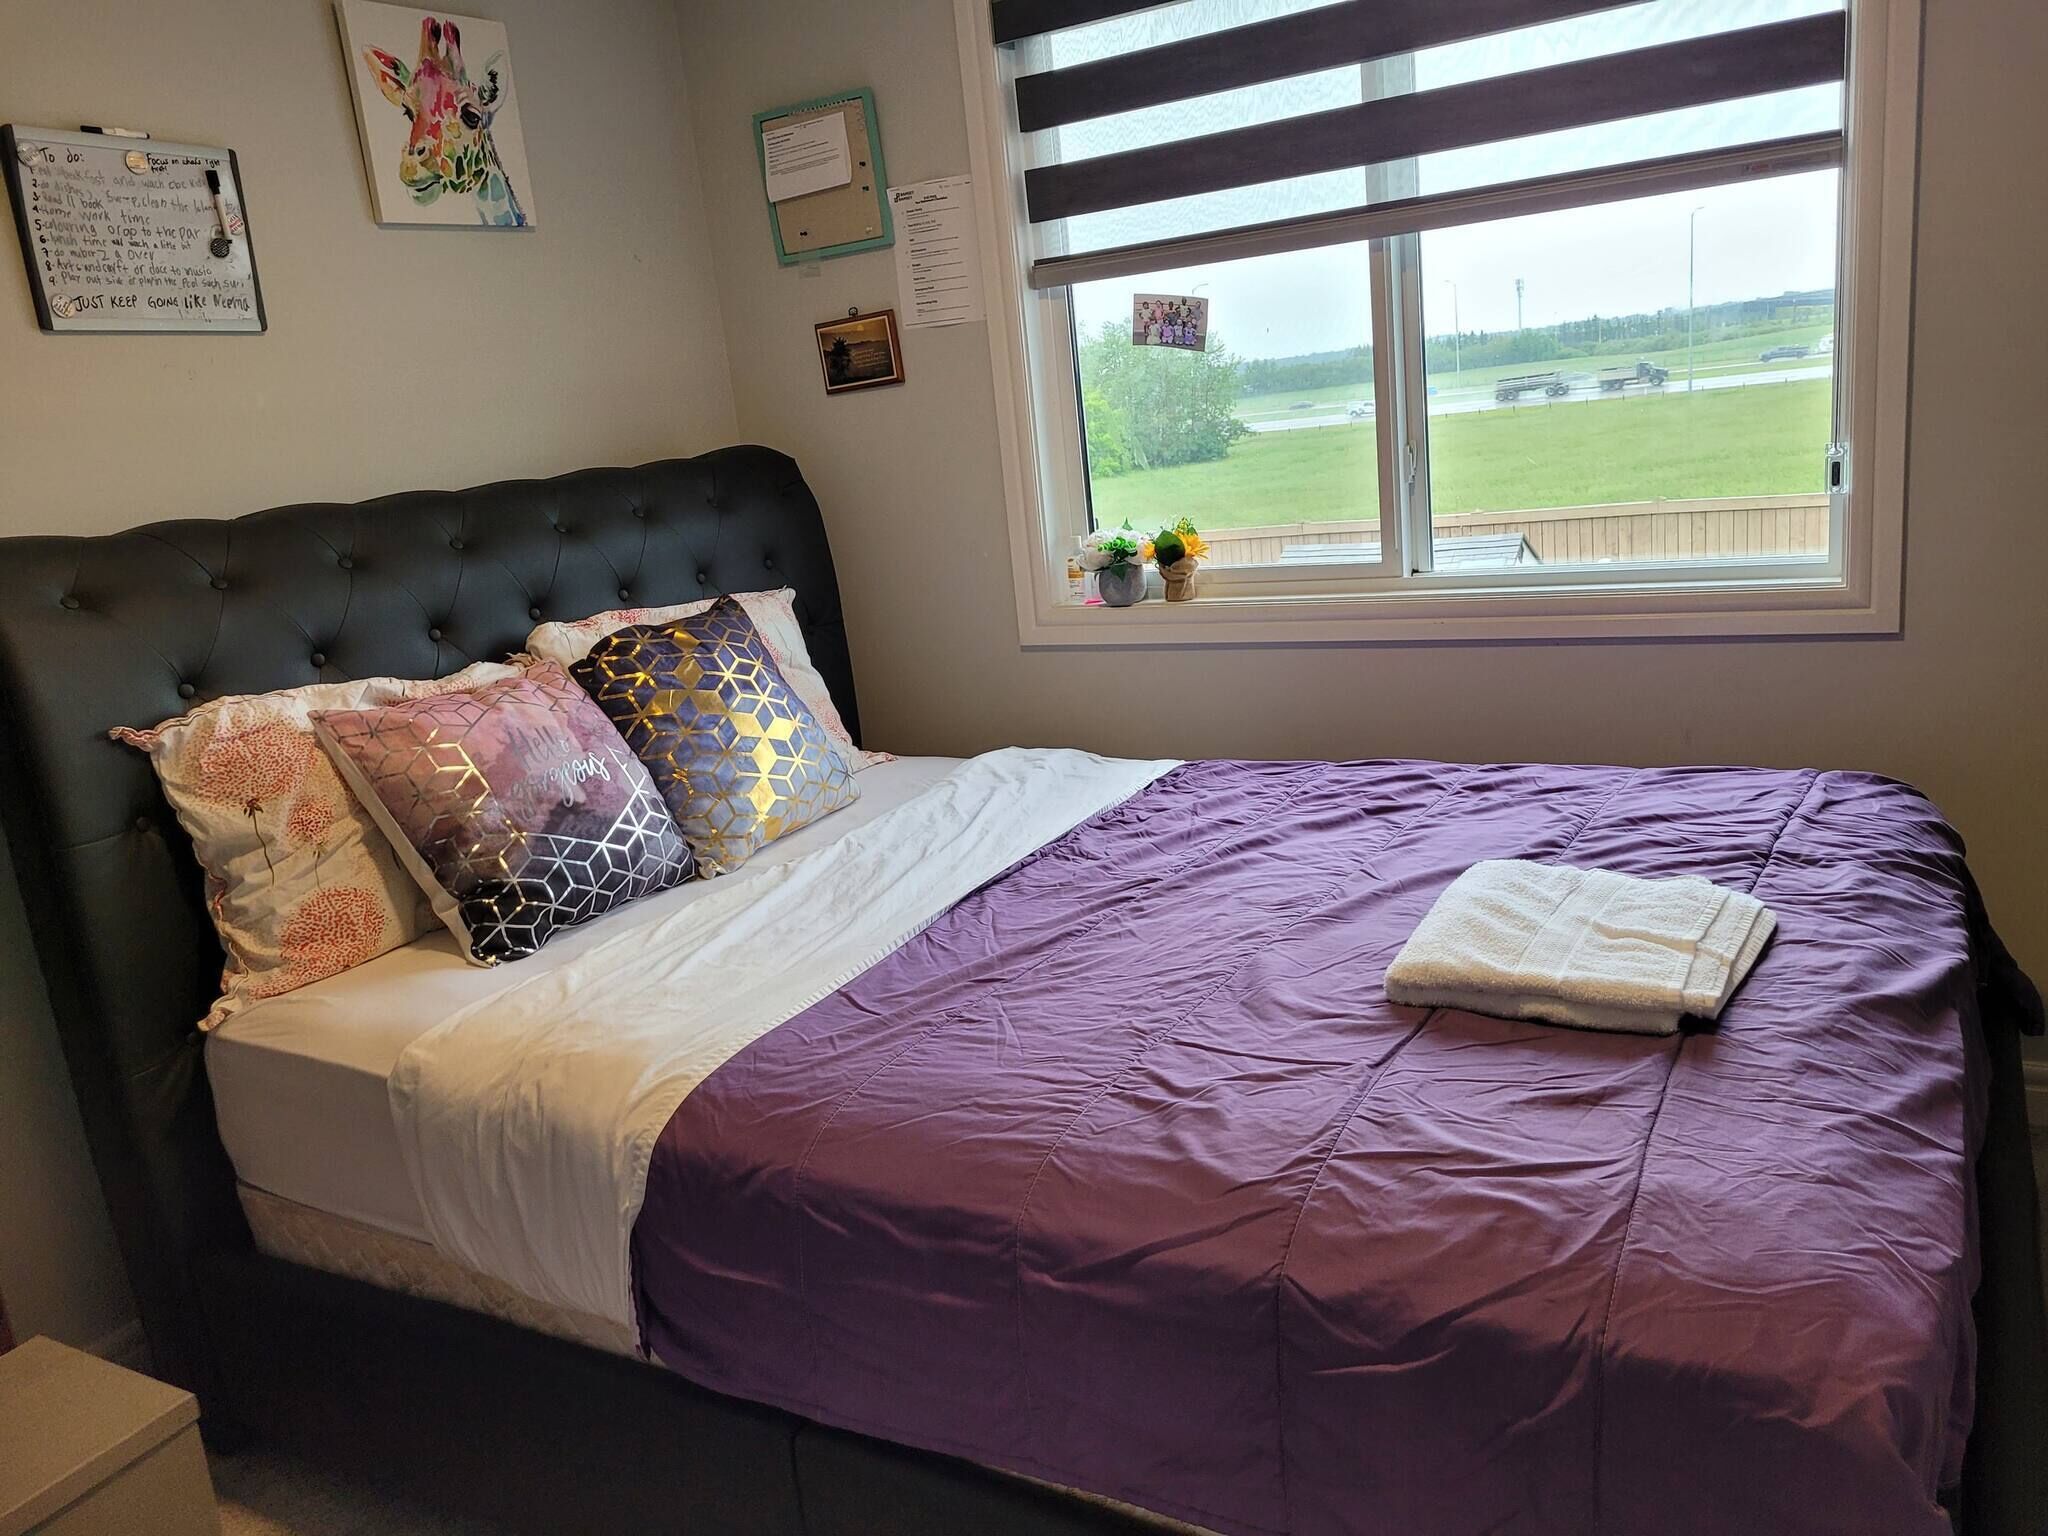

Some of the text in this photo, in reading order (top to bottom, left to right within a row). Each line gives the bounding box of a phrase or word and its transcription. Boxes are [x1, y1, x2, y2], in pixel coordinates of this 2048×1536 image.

[40, 147, 55, 162] To
[146, 153, 168, 166] Focus
[72, 295, 104, 312] JUST
[111, 294, 137, 308] KEEP
